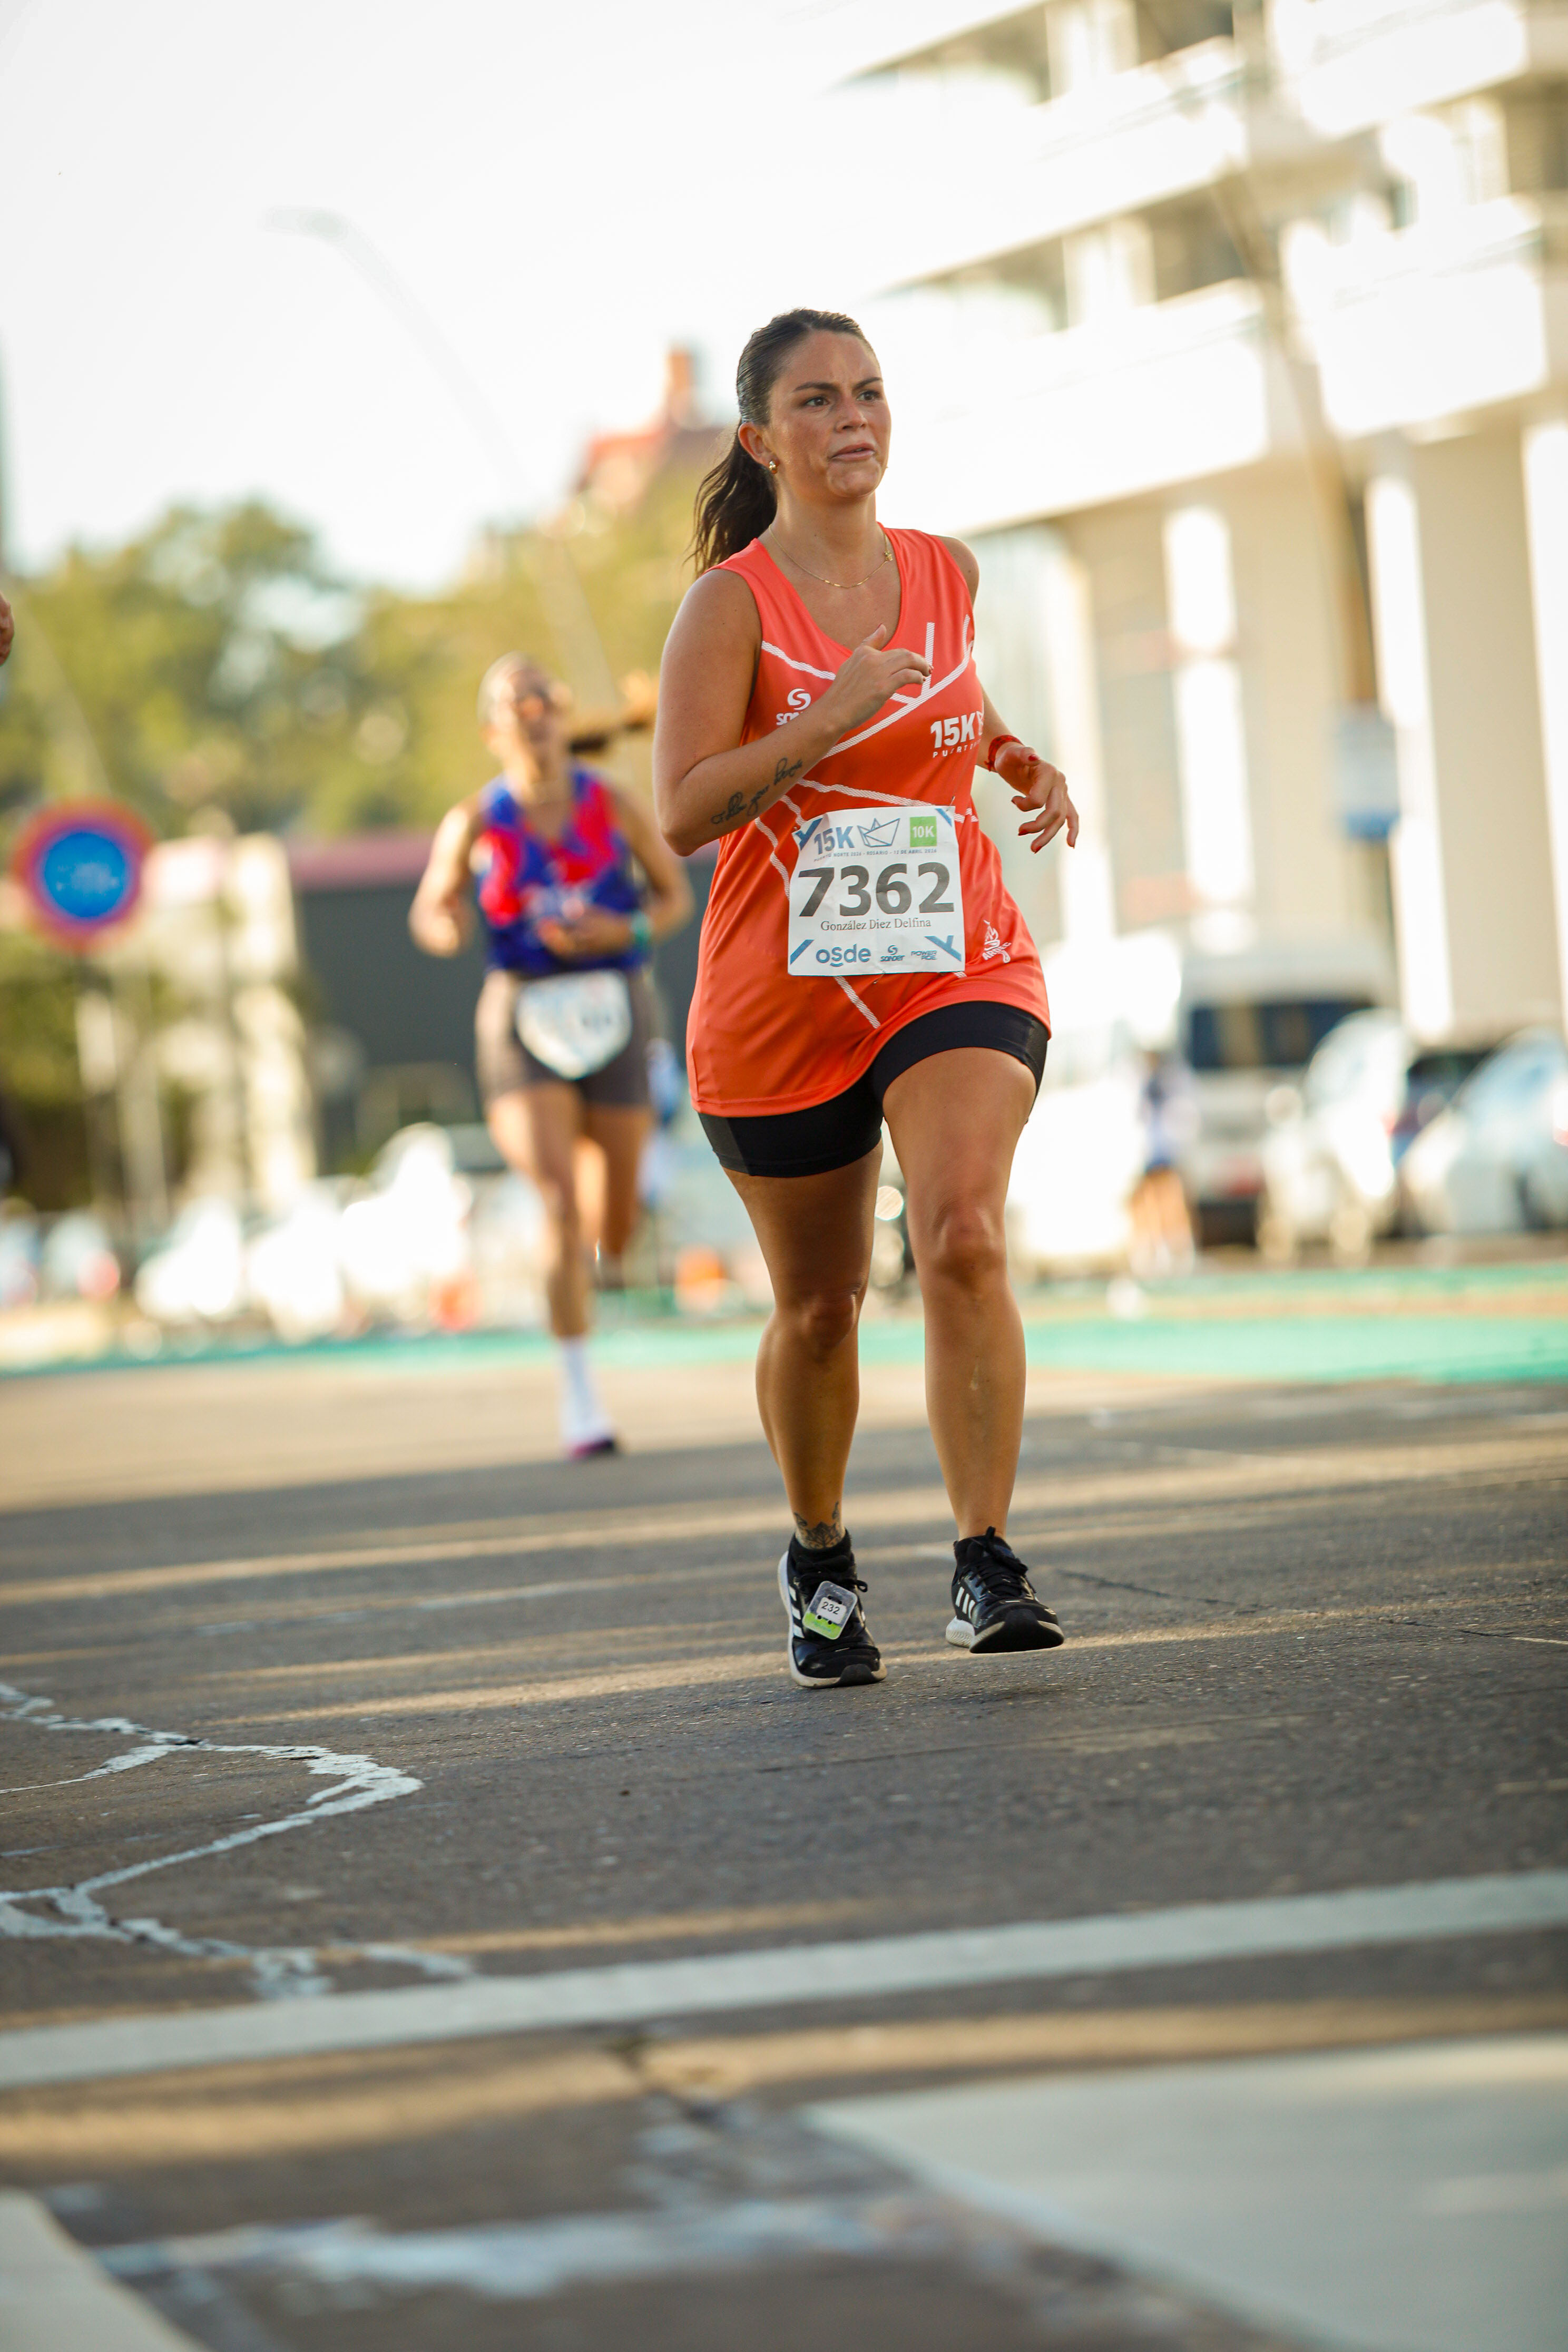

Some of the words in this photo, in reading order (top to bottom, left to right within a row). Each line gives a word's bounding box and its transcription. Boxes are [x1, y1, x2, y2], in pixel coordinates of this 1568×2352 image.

[930, 712, 976, 748] 15K
[814, 826, 855, 855] 15K
[912, 825, 935, 838] 10K
[798, 862, 954, 917] 7362
[821, 920, 867, 931] González
[895, 917, 932, 928] Delfina
[816, 943, 871, 964] osde
[821, 1601, 840, 1615] 232
